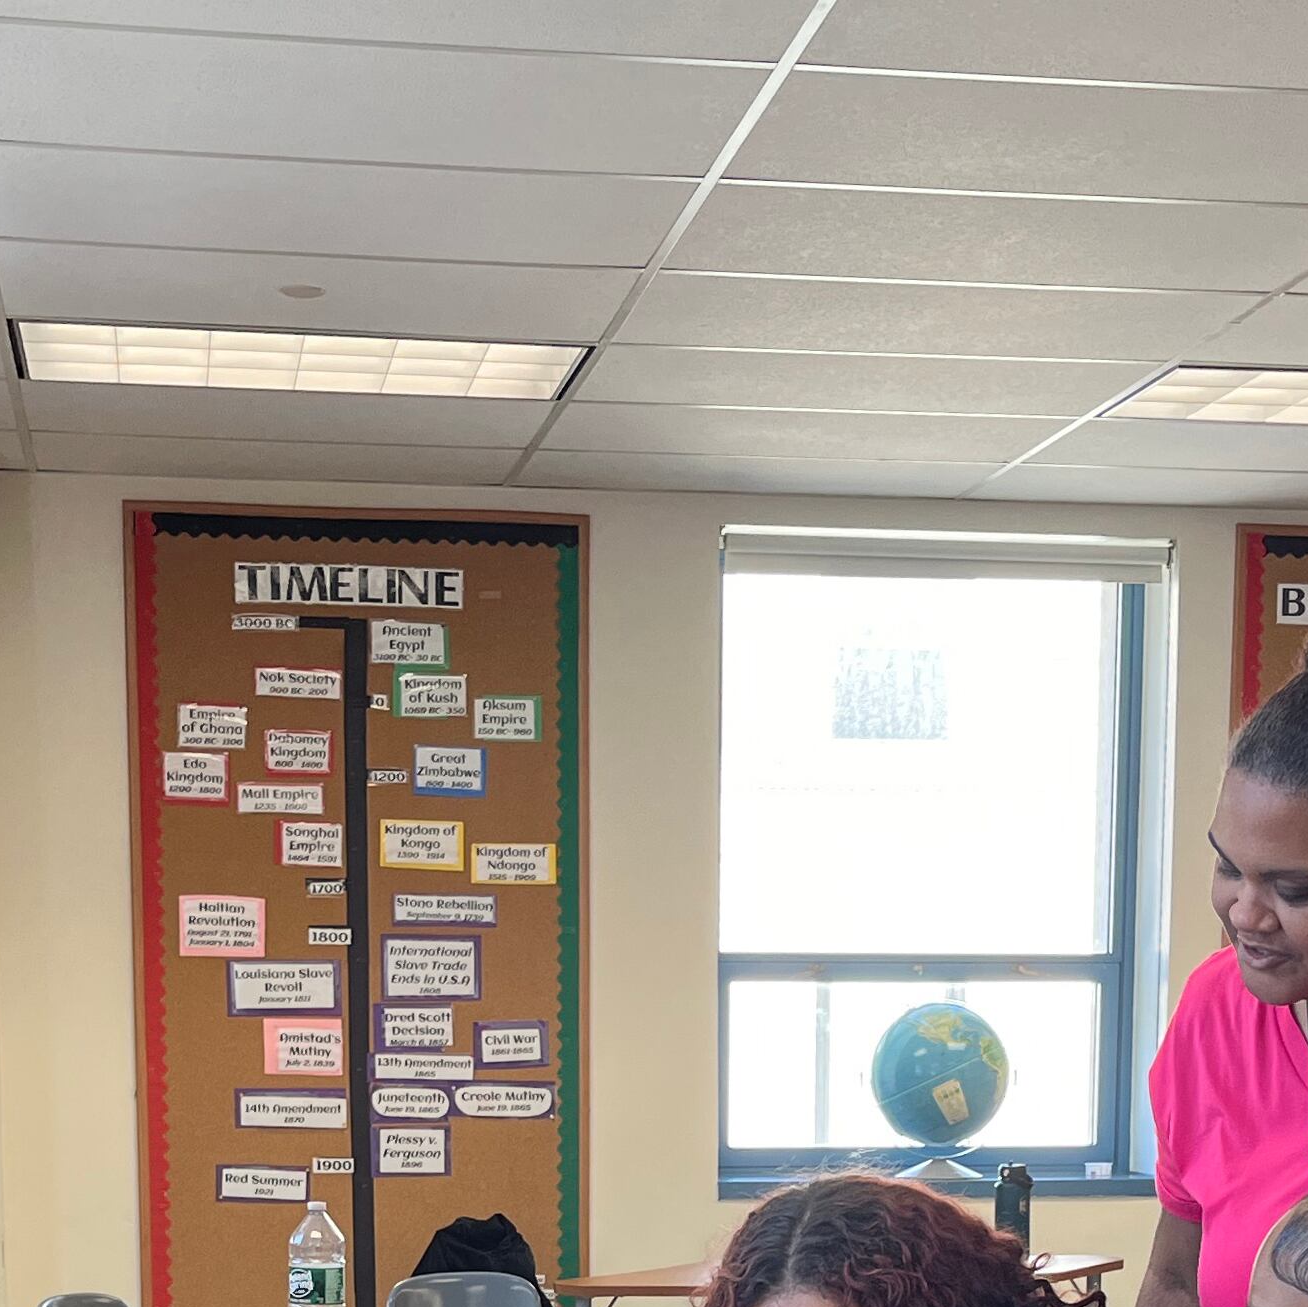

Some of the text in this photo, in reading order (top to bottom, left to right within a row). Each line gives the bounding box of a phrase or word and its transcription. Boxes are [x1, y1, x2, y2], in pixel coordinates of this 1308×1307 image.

[238, 565, 460, 607] TIMELINE
[234, 618, 293, 628] 3000 BC
[383, 625, 432, 637] Ancient
[389, 639, 425, 653] Egypt
[259, 671, 337, 687] Nok Society
[404, 679, 461, 692] Kingdom
[375, 698, 384, 706] 0
[409, 691, 458, 704] of Kush
[483, 700, 526, 711] Aksum
[482, 714, 527, 727] Empire
[182, 722, 243, 735] of Ghana
[269, 733, 328, 746] Dahomey
[270, 747, 326, 759] Kingdom
[431, 753, 466, 764] Great
[183, 759, 207, 769] Edo
[373, 772, 405, 782] 1200
[417, 766, 481, 778] Zimbabwe
[166, 772, 223, 785] Kingdom
[242, 789, 319, 802] Mali Empire
[285, 826, 339, 840] Songhai
[385, 825, 457, 838] Kingdom of
[289, 841, 335, 853] Empire
[401, 839, 441, 851] Kongo
[476, 847, 548, 860] Kingdom of
[487, 860, 536, 873] Ndongo
[311, 883, 342, 893] 1700
[198, 902, 245, 914] Haitian
[397, 898, 494, 912] Stono Rebellion
[188, 915, 256, 928] Revolution
[311, 931, 349, 943] 1800
[389, 946, 473, 958] International
[395, 960, 468, 971] Slave Trade
[235, 968, 333, 980] Louisiana Slave
[391, 975, 421, 985] Ends
[258, 995, 293, 1004] January
[384, 1013, 450, 1023] Dred Scott
[392, 1026, 445, 1037] Decision
[279, 1033, 342, 1044] Amistad's
[484, 1034, 538, 1046] Civil War
[289, 1047, 332, 1058] Mutiny
[377, 1058, 472, 1069] 13th Amendment
[377, 1092, 446, 1104] Juneteenth
[461, 1091, 546, 1102] Creole Mutiny
[245, 1104, 341, 1114] 14th Amendment
[386, 1134, 428, 1146] Plessy
[382, 1149, 442, 1162] Ferguson
[316, 1160, 352, 1171] 1900
[225, 1173, 304, 1187] Red Summer
